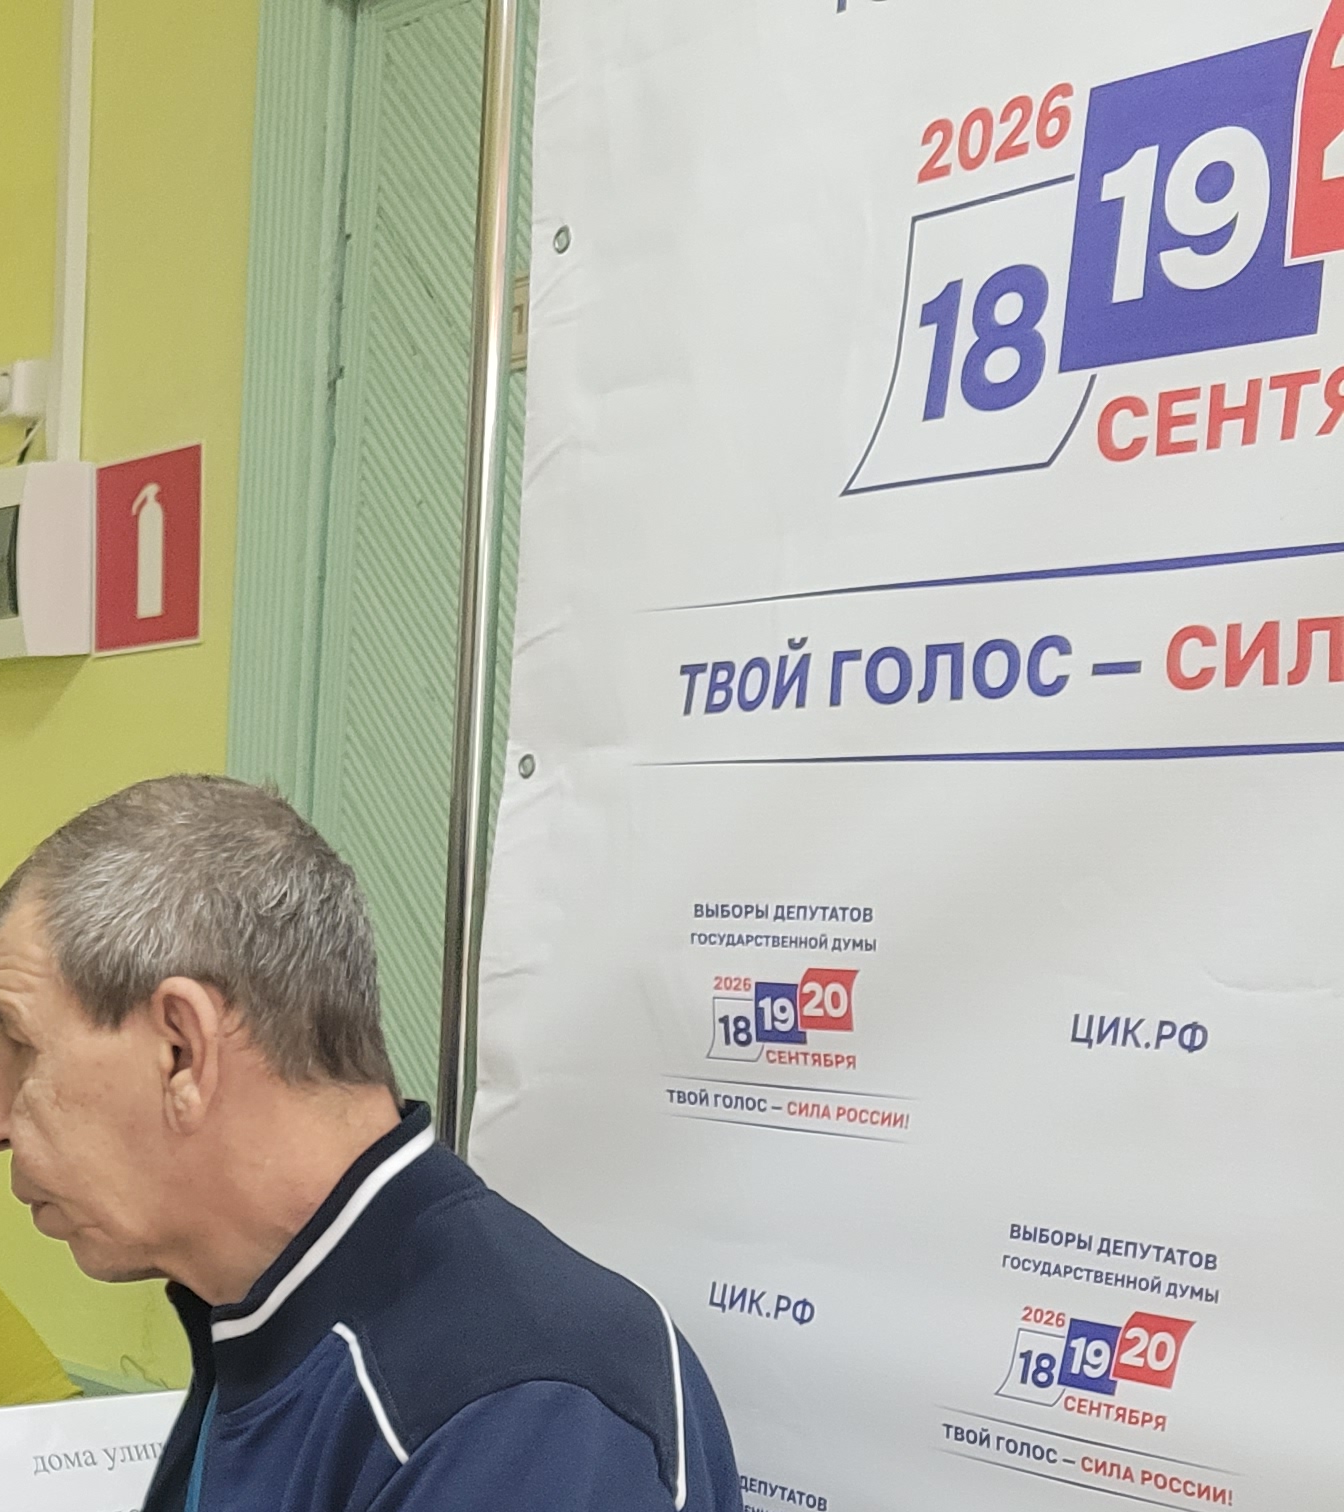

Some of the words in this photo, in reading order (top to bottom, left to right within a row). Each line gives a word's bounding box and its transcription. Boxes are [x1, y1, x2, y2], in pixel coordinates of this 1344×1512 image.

[918, 82, 1074, 185] 2026
[1101, 125, 1270, 303] 19
[919, 263, 1049, 422] 18
[679, 636, 813, 717] ТВОЙ
[829, 634, 1073, 707] ГОЛОС
[694, 903, 769, 920] ВЫБОРЫ
[773, 905, 874, 923] ДЕПУТАТОВ
[691, 932, 828, 951] ГОСУДАРСТВЕННОЙ
[831, 937, 877, 953] ДУМЫ
[713, 976, 752, 992] 2026
[802, 982, 848, 1018] 20
[718, 1014, 753, 1047] 18
[759, 996, 795, 1032] 19
[1071, 1013, 1208, 1053] ЦИК.РФ
[766, 1050, 857, 1070] СЕНТЯБРЯ
[666, 1089, 709, 1108] ТВОЙ
[714, 1093, 767, 1112] ГОЛОС
[787, 1101, 831, 1120] СИЛА
[836, 1106, 910, 1130] РОССИИ!
[1009, 1223, 1092, 1251] ВЫБОРЫ
[1096, 1237, 1218, 1270] ДЕПУТАТОВ
[1002, 1254, 1162, 1294] ГОСУДАРСТВЕННОЙ
[1165, 1282, 1219, 1304] ДУМЫ
[709, 1281, 815, 1325] ЦИК.РФ
[1021, 1305, 1066, 1328] 2026
[1019, 1349, 1056, 1389] 18
[1069, 1337, 1112, 1379] 19
[1119, 1327, 1176, 1371] 20
[1063, 1395, 1167, 1432] СЕНТЯБРЯ
[32, 1449, 97, 1476] дома
[942, 1423, 991, 1448] ТВОЙ
[996, 1435, 1058, 1464] ГОЛОС
[1081, 1456, 1135, 1483] СИЛА
[1141, 1468, 1233, 1507] РОССИИ!
[739, 1475, 828, 1512] ДЕПУТАТОВ
